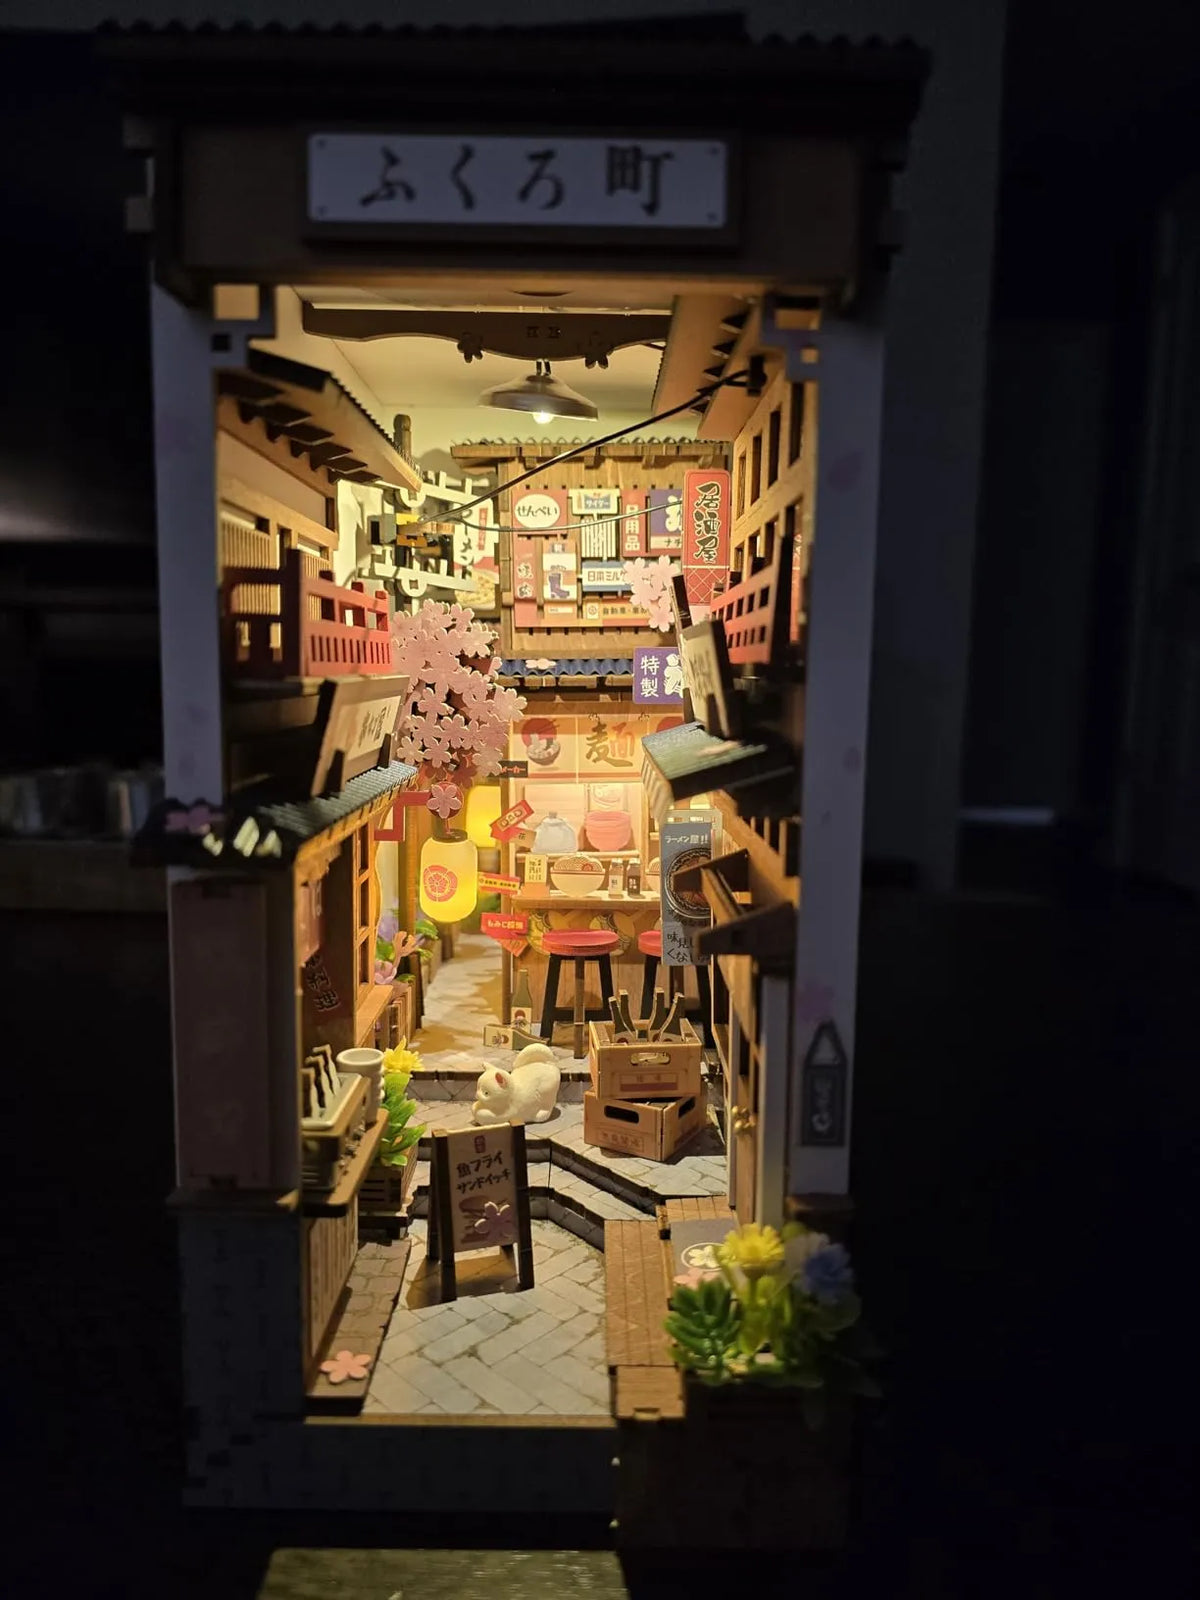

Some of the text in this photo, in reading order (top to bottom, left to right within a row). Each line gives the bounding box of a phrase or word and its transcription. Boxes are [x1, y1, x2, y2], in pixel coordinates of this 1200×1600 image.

[358, 142, 675, 218] ふくろ町
[516, 504, 558, 519] せんべい
[693, 480, 722, 565] 居酒屋
[640, 654, 661, 699] 特製
[455, 1167, 511, 1195] サンドイッチ
[456, 1149, 504, 1179] 魚フライ
